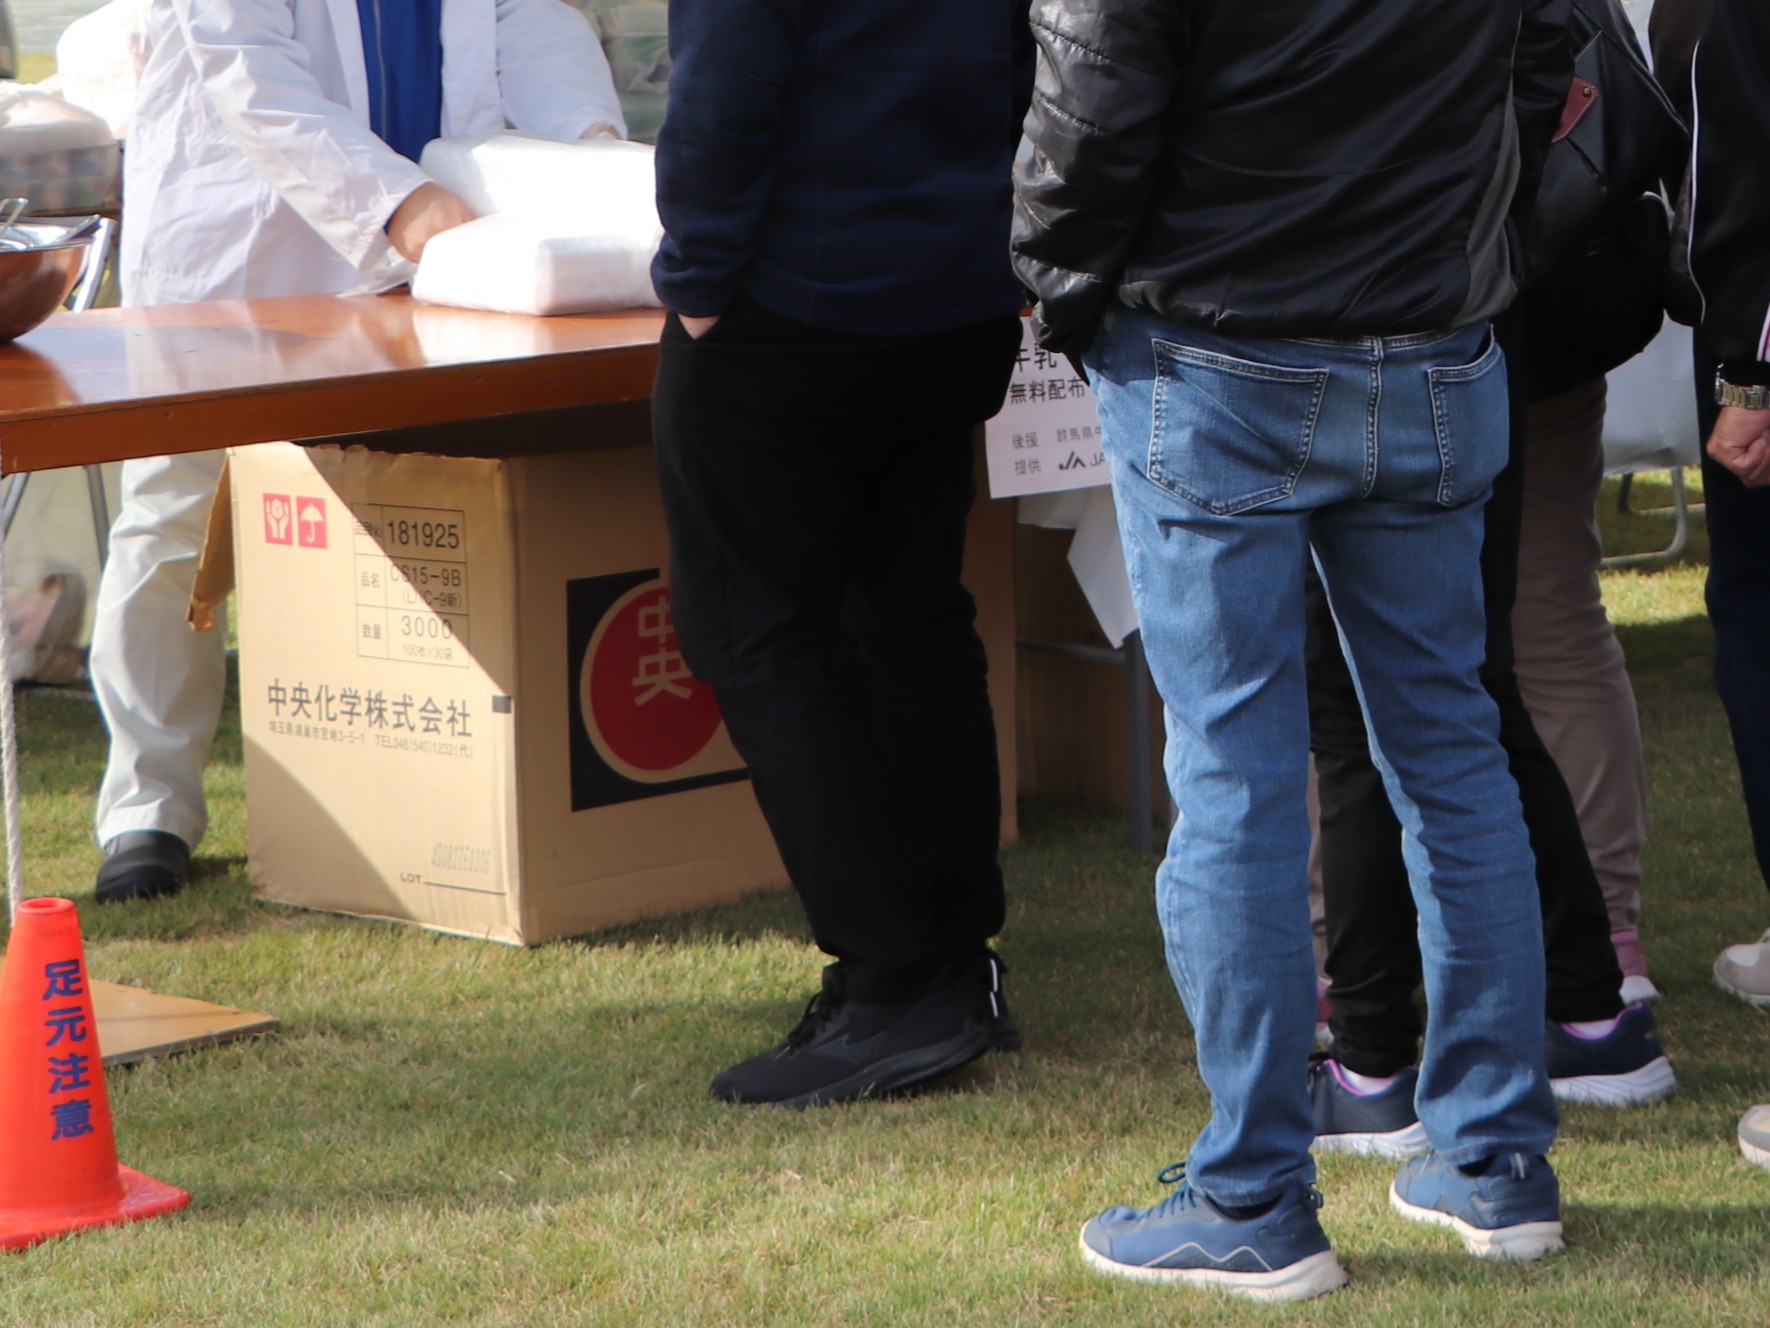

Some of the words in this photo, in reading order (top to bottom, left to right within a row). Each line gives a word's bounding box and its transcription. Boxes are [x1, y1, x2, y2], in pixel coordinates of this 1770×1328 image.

[1010, 376, 1085, 404] 無料配布
[1012, 432, 1039, 449] 後援
[1014, 458, 1041, 476] 提供
[388, 520, 460, 549] 181925
[390, 563, 461, 587] CS15-9B
[401, 615, 453, 639] 3000
[268, 678, 473, 738] 中央化学株式会社
[42, 959, 94, 1141] 足元注意
